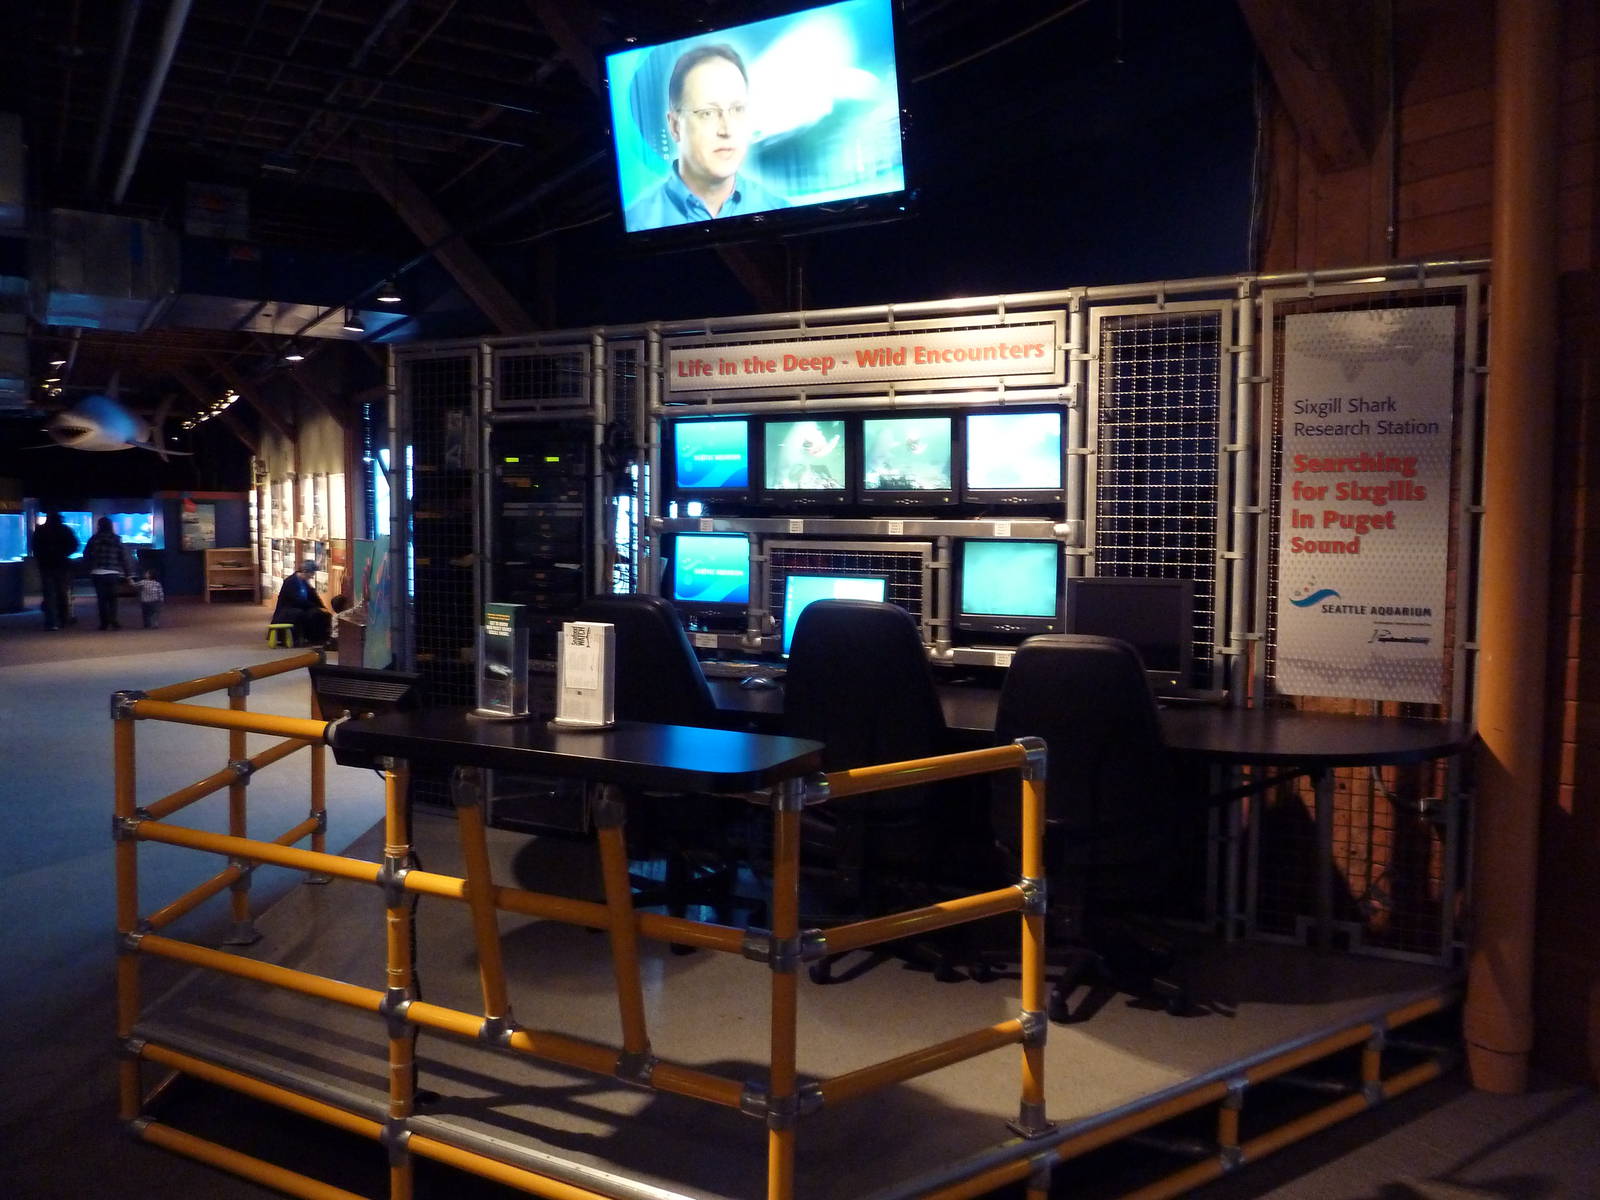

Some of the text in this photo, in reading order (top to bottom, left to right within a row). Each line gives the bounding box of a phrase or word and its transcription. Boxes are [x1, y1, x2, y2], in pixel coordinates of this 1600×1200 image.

[677, 358, 713, 378] Life
[718, 358, 738, 375] in
[743, 355, 777, 374] the
[783, 353, 836, 376] Deep
[855, 345, 906, 368] Wild
[914, 341, 1045, 365] Encounters
[1294, 397, 1397, 418] Sixgill Shark
[1294, 419, 1440, 437] Research Station
[1294, 452, 1418, 478] Searching
[1292, 479, 1427, 506] for Sixgills
[1322, 510, 1396, 535] Puget
[1291, 536, 1361, 555] Sound
[1321, 604, 1433, 618] SEATTLE AQUARIUM
